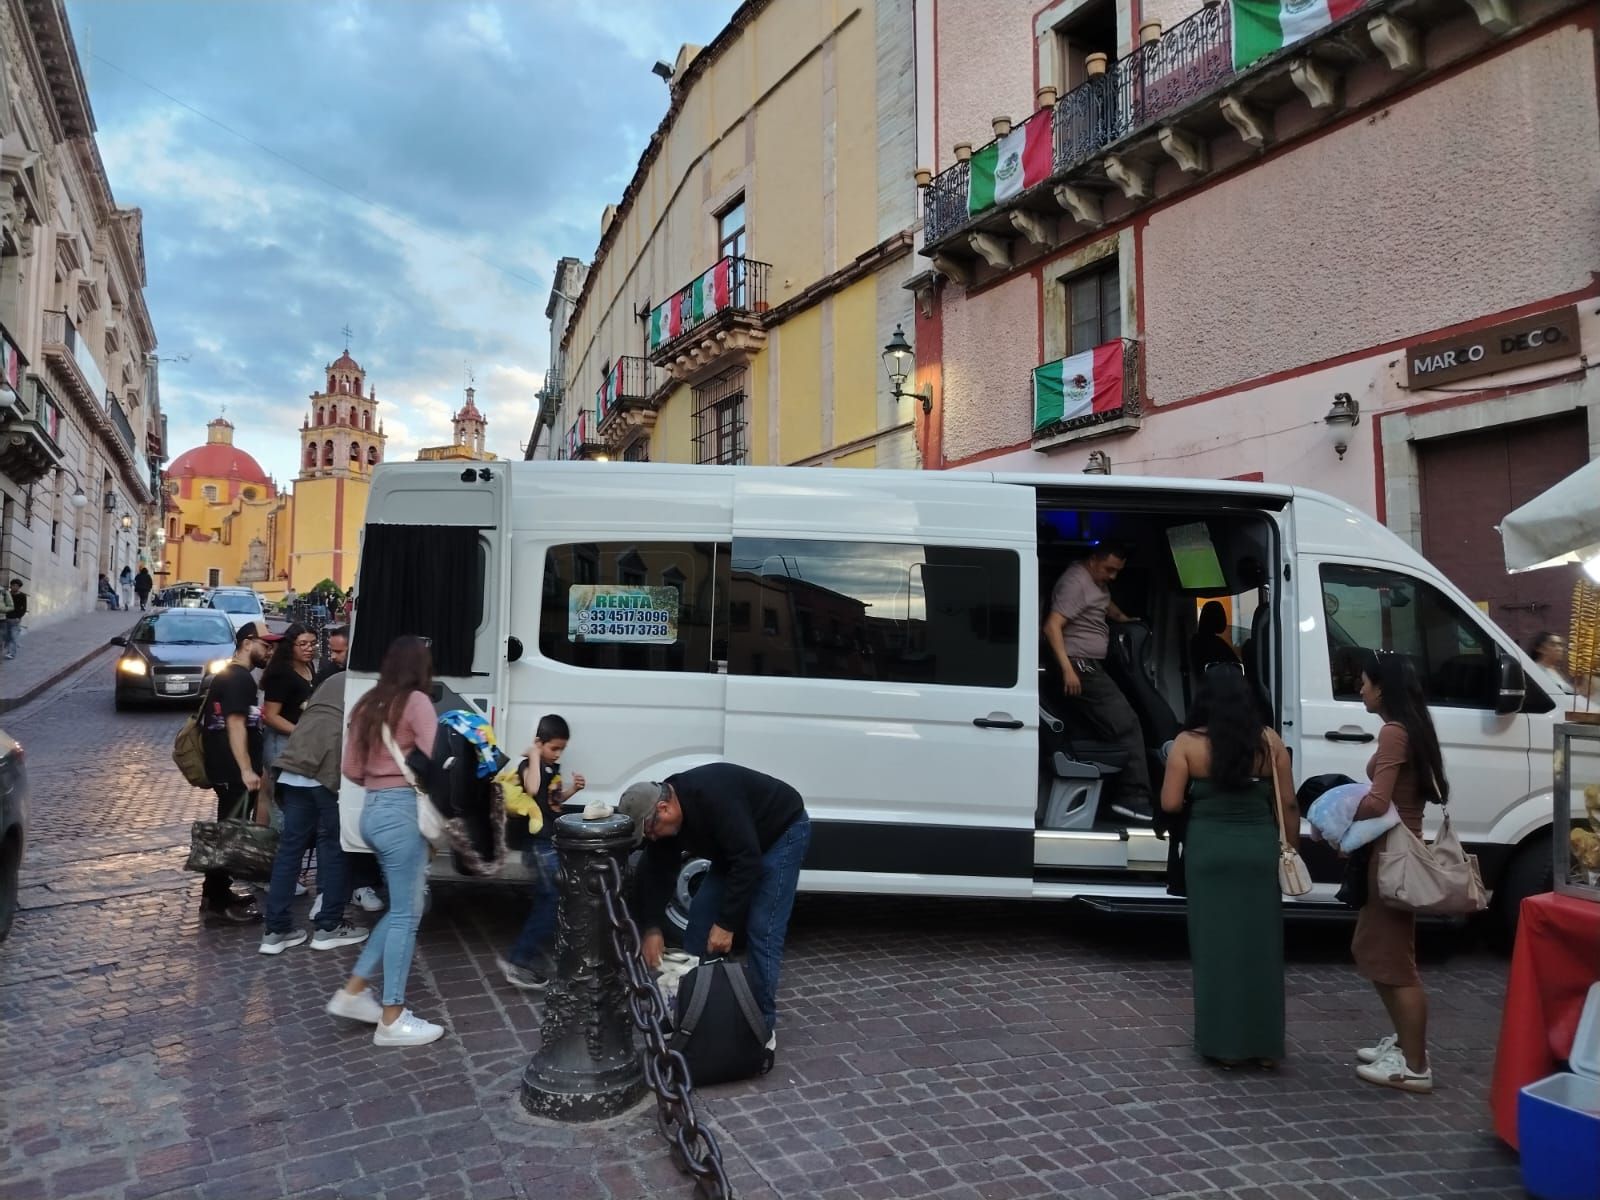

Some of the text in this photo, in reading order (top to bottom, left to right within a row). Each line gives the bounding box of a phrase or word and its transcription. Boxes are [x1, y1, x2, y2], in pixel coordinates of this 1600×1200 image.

[1414, 345, 1484, 374] MARCO
[595, 595, 652, 609] RENTA
[591, 610, 668, 623] 33 4517 3096
[591, 623, 668, 635] 33 4517 3738
